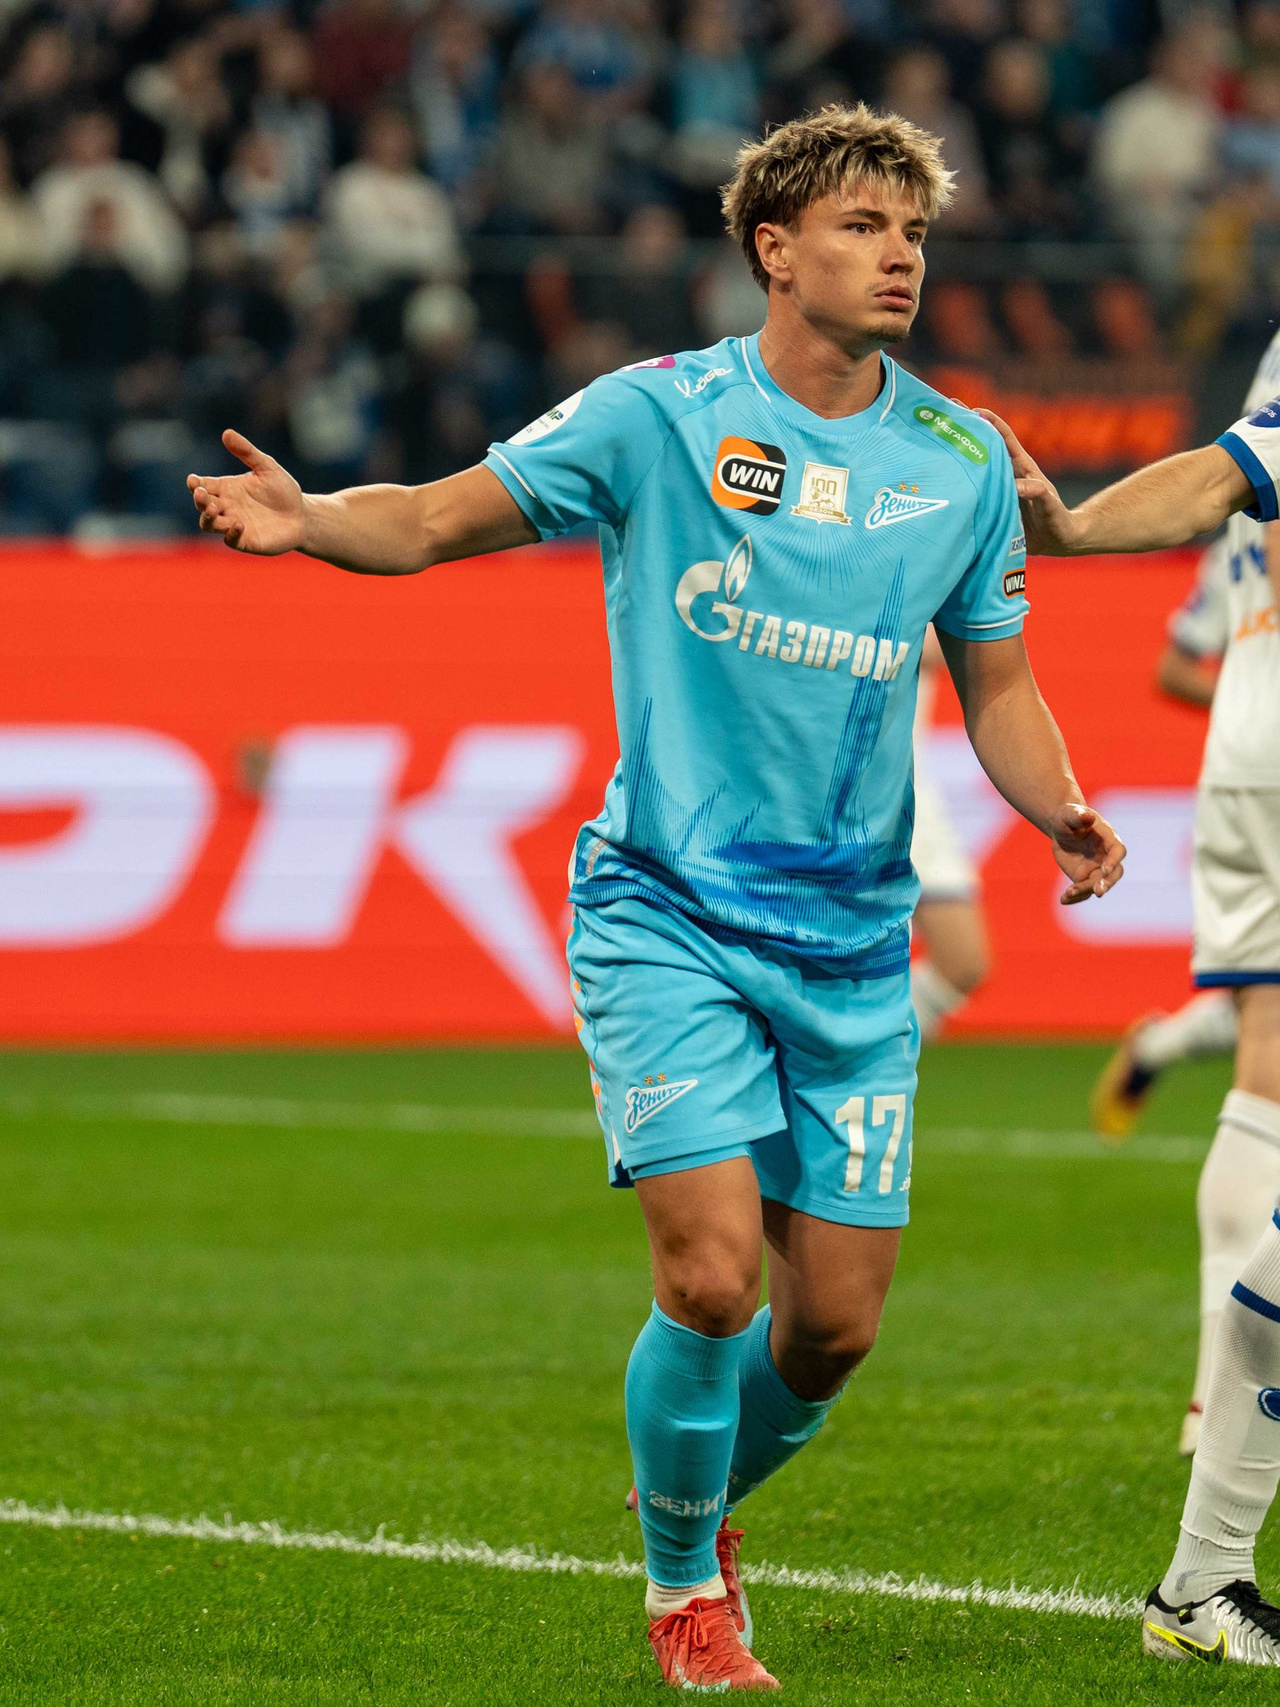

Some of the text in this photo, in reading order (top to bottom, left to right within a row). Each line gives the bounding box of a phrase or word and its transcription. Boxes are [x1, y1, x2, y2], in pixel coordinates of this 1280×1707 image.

[729, 463, 780, 492] WIN
[738, 610, 910, 682] ГАЗПРОМ
[835, 1093, 906, 1193] 17
